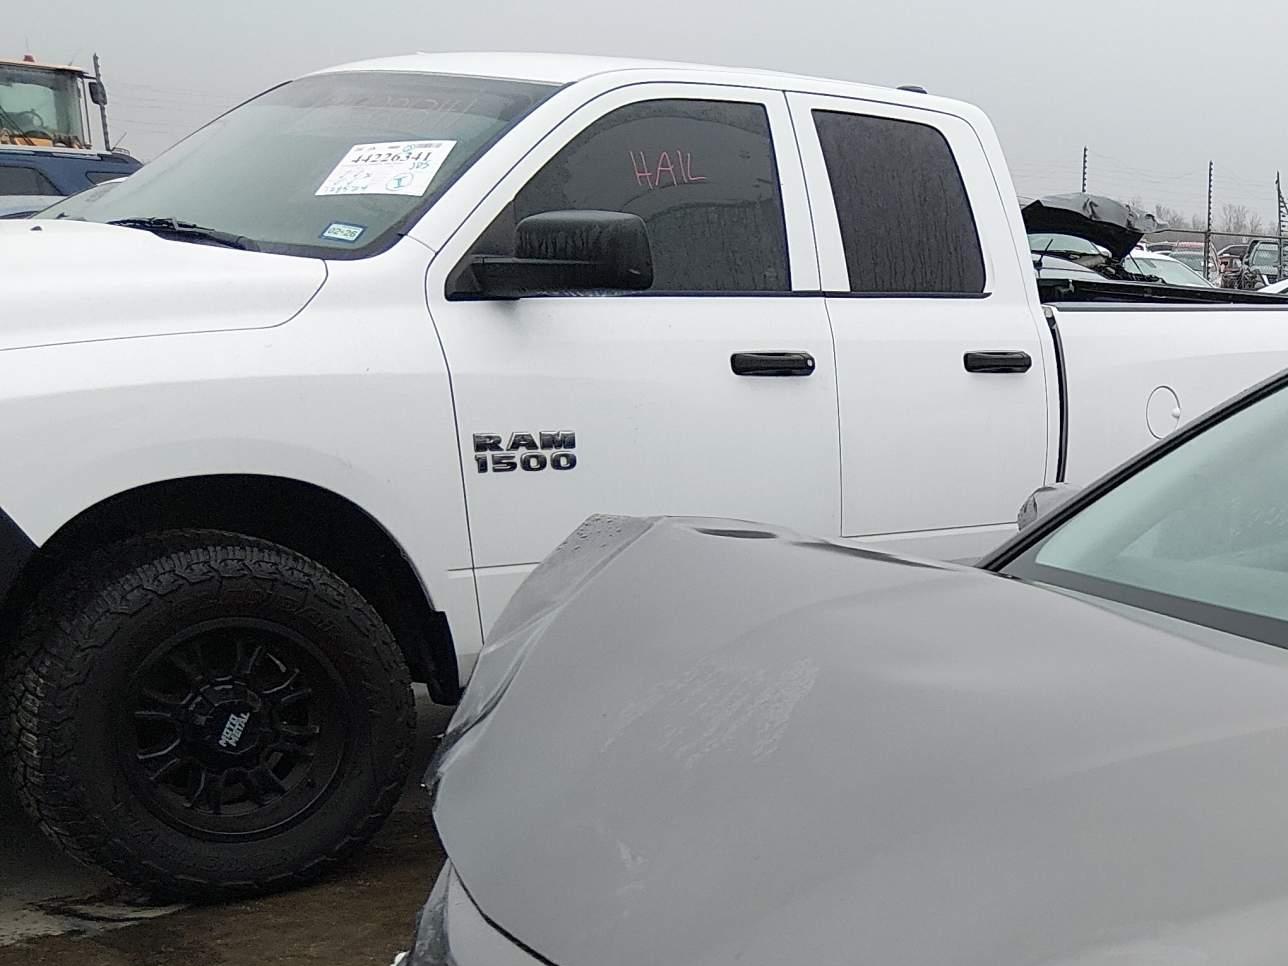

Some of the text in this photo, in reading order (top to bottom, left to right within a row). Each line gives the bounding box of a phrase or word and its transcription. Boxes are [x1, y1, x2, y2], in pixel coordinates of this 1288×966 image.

[629, 149, 707, 190] HAIL
[472, 431, 576, 453] RAM
[474, 451, 577, 474] 1500
